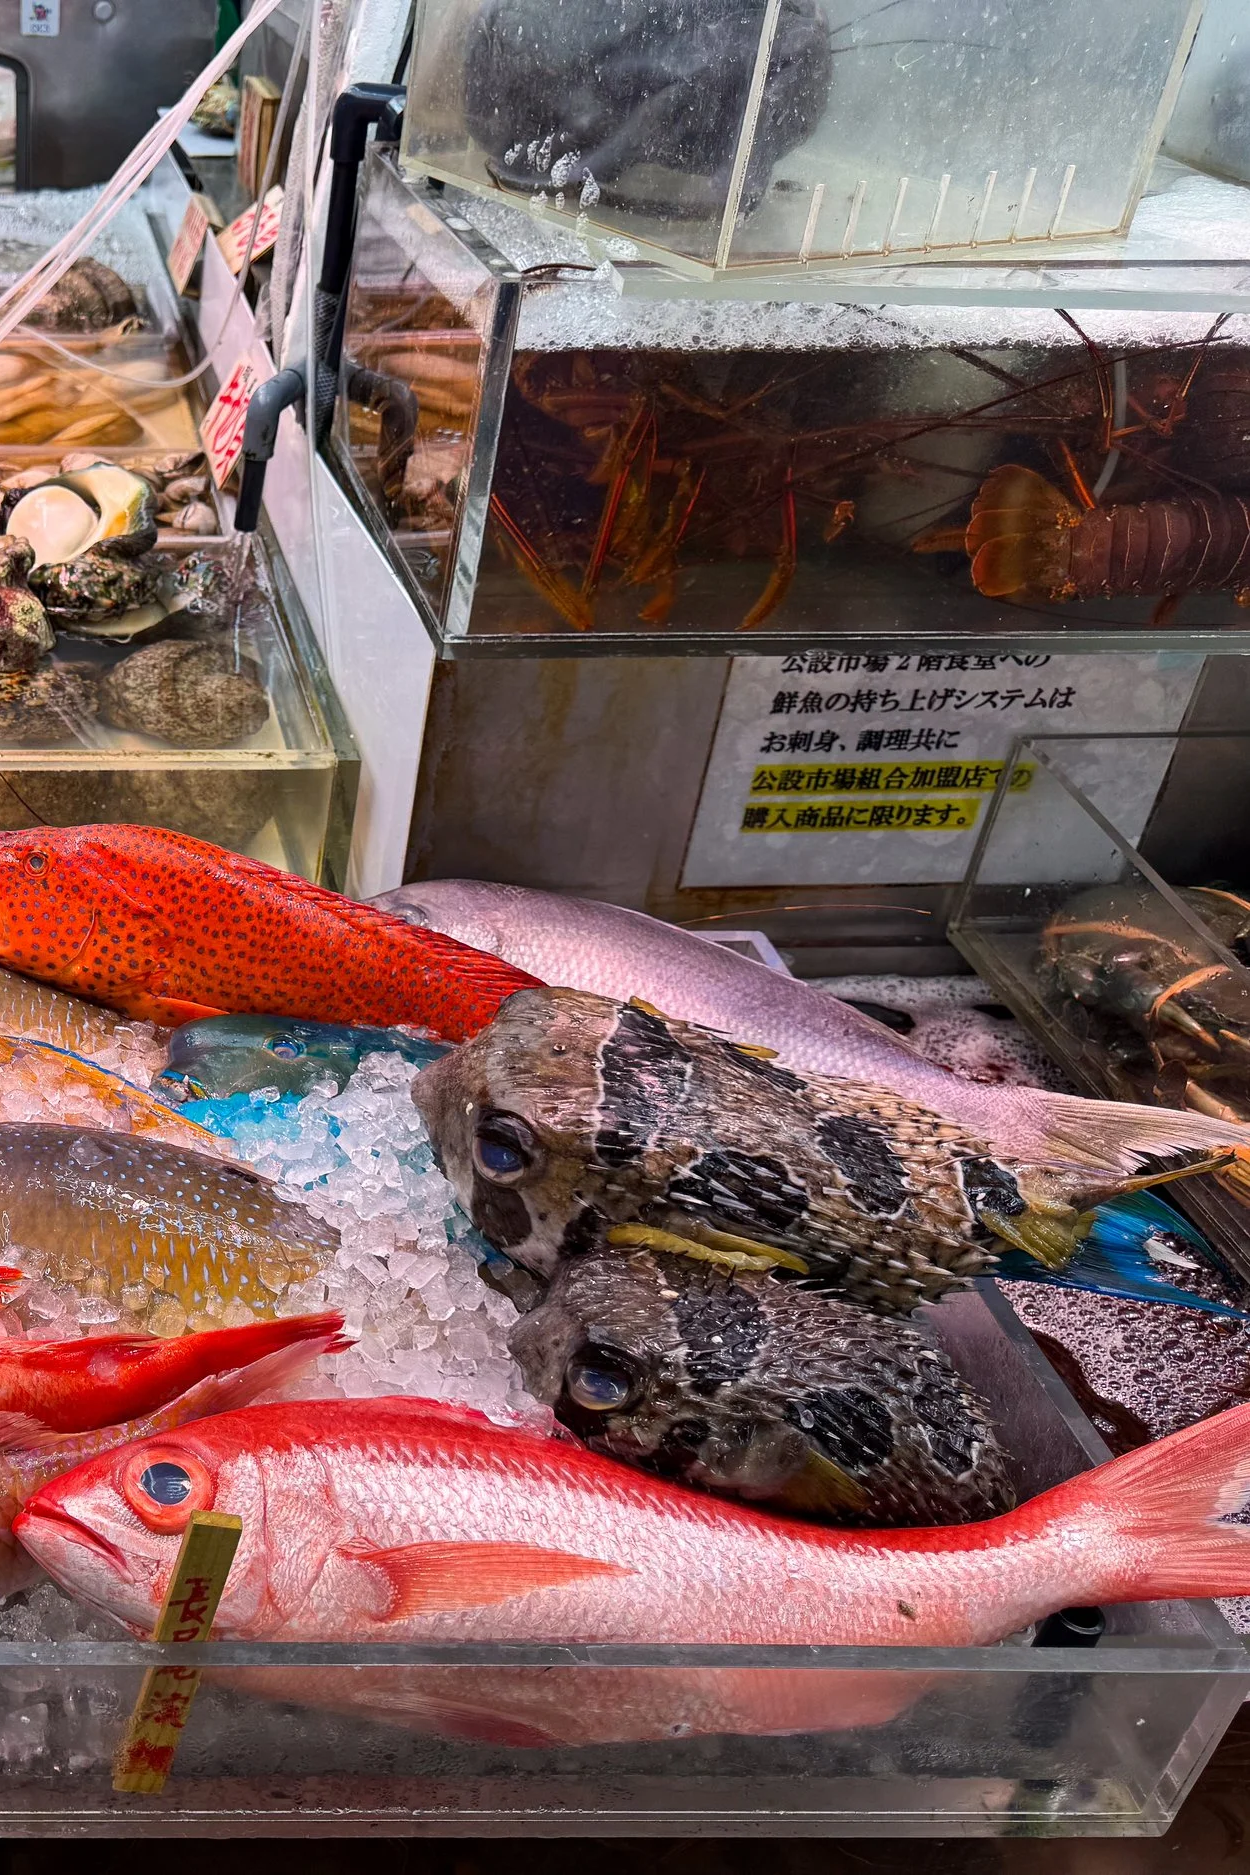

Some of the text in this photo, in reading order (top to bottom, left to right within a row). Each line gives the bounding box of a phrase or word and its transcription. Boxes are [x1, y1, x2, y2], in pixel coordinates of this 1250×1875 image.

[768, 686, 1077, 716] 鮮魚の持ち上げシステムは
[759, 729, 962, 754] お刺身、調理共に
[740, 802, 969, 832] 購入商品に限ります。
